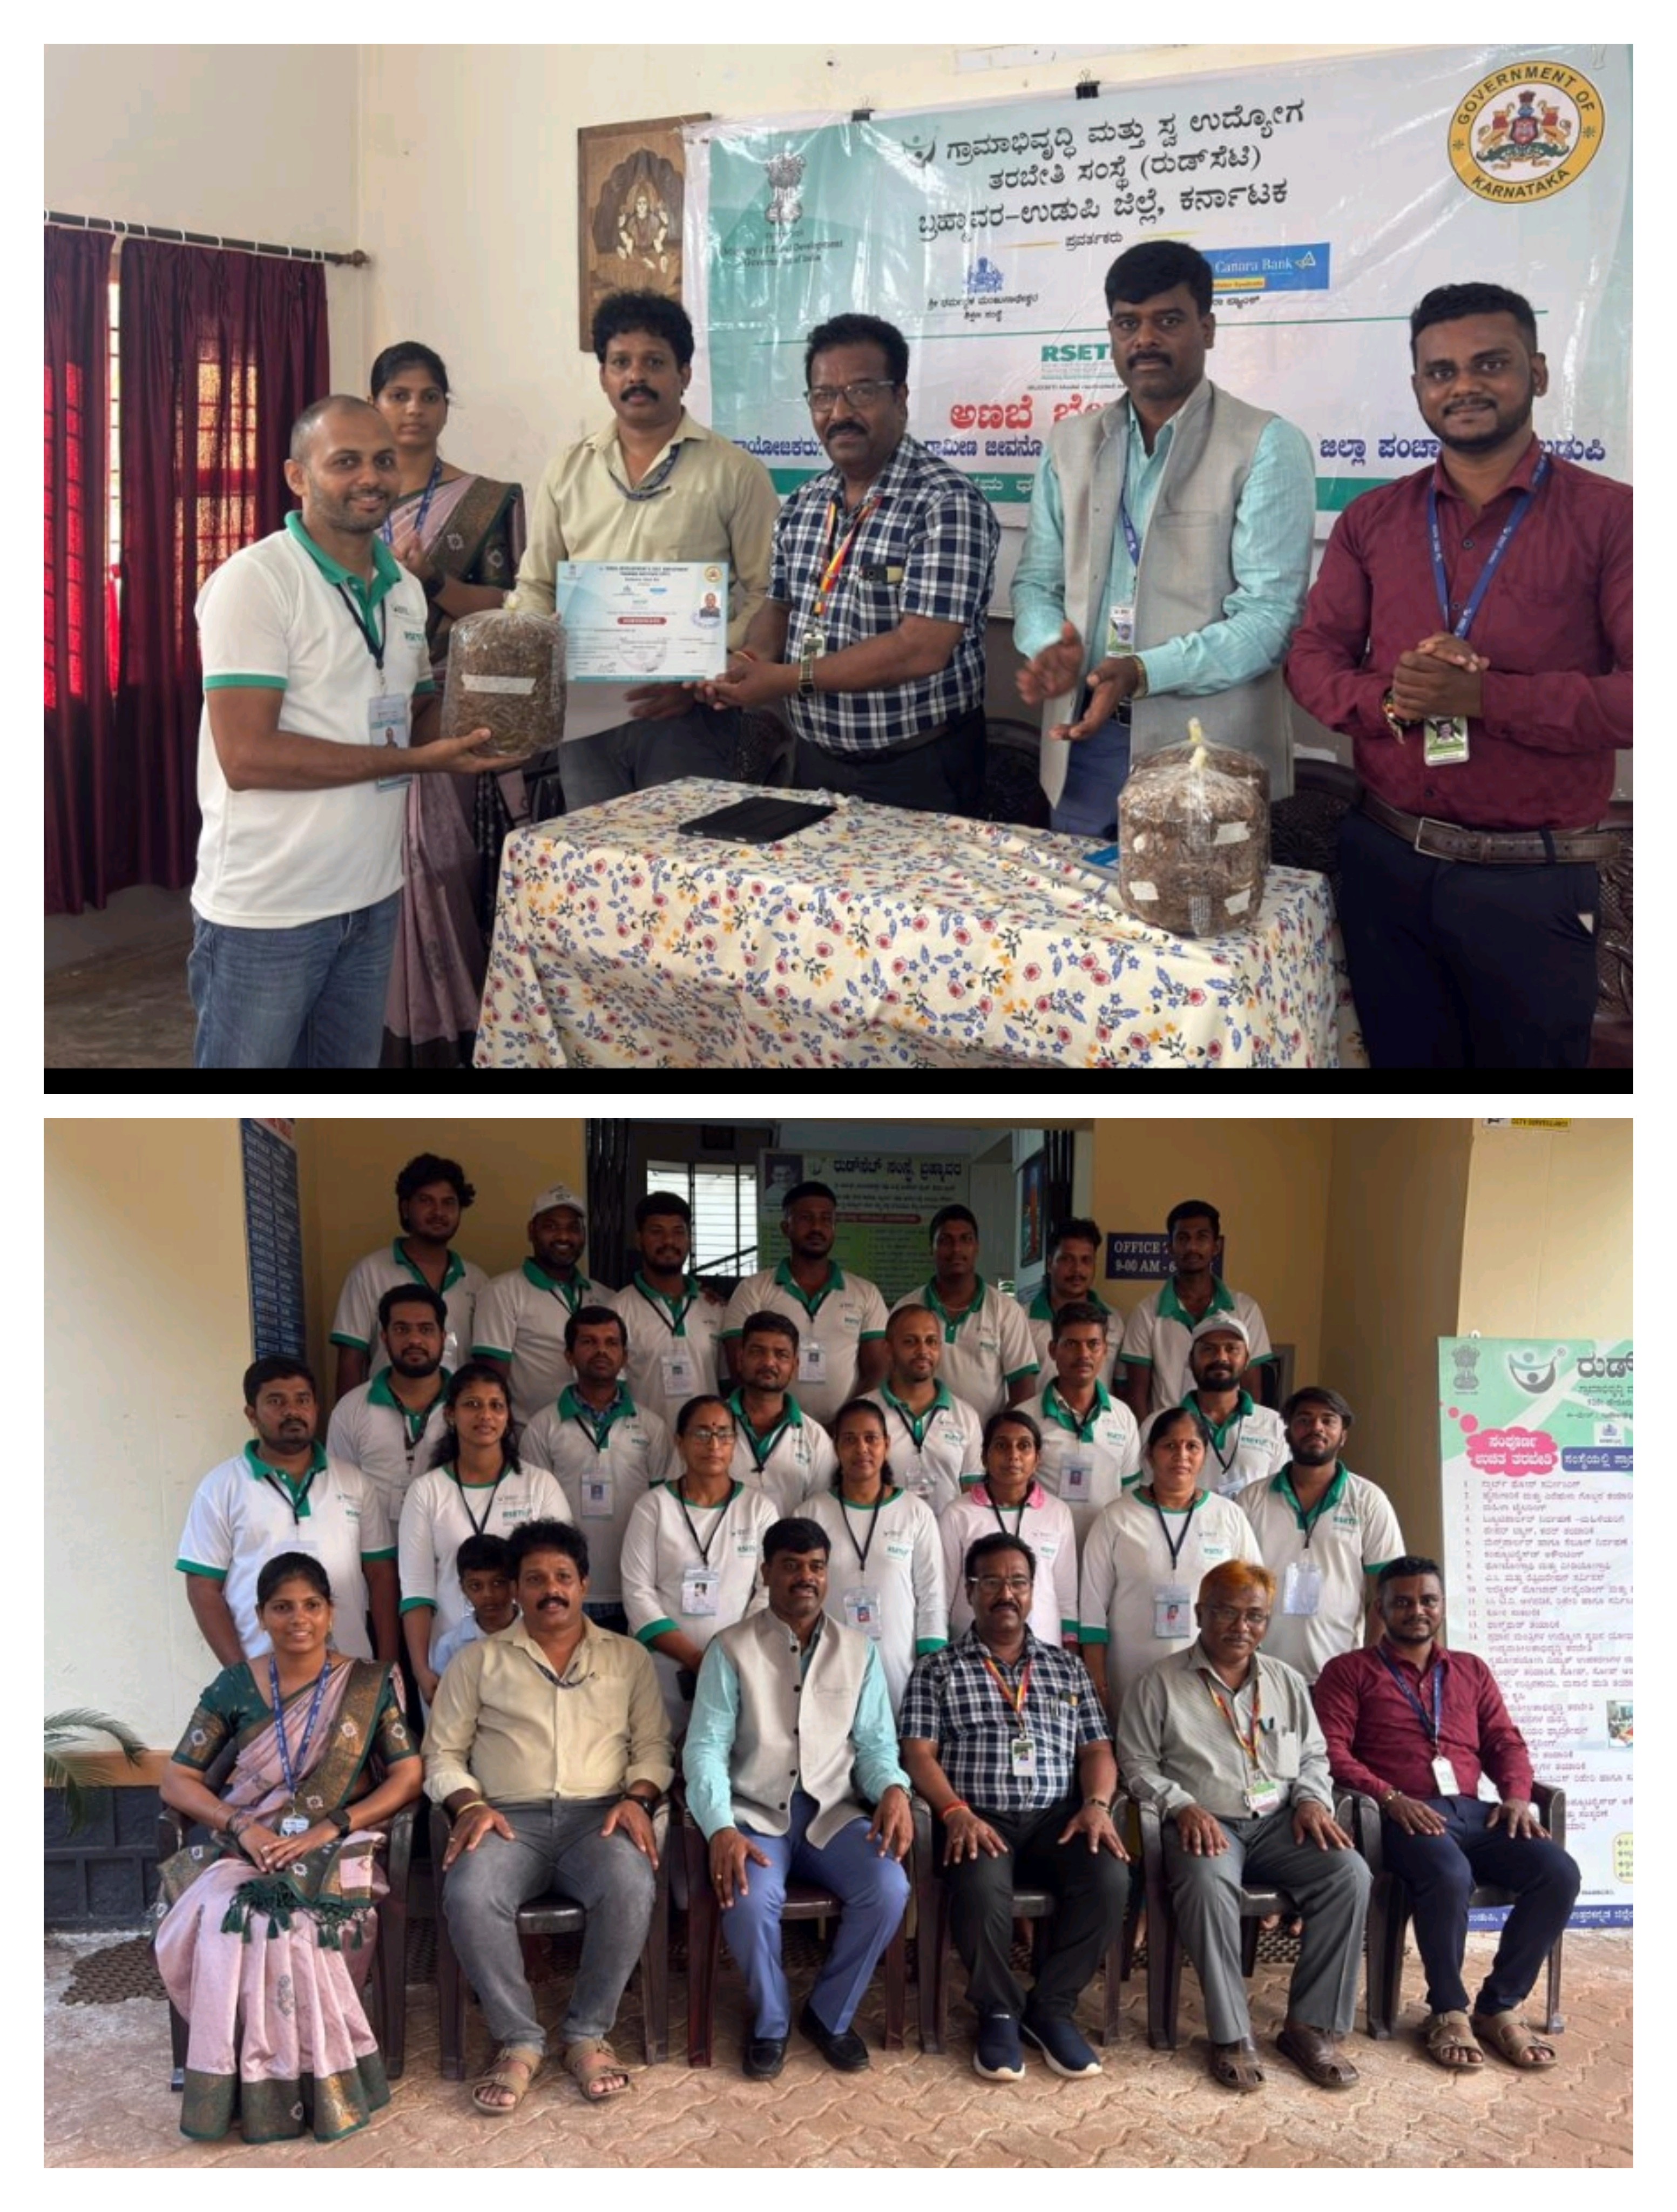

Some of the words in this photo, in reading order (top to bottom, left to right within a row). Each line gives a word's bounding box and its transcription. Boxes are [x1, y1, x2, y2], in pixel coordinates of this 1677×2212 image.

[1458, 66, 1578, 124] GOVERNMENT
[1576, 91, 1595, 112] OF
[946, 126, 1077, 165] ಗ್ರಾಮಾಭಿವೃದ್ಧಿ
[1088, 117, 1145, 149] ಮತ್ತು
[1158, 113, 1178, 146] ಸ್ವ
[1190, 99, 1304, 138] ಉದ್ಯೋಗ
[989, 163, 1065, 191] ತರಬೇತಿ
[1078, 155, 1130, 190] ಸಂಸ್ಥೆ
[1472, 168, 1570, 198] KARNATAKA
[1114, 188, 1165, 225] ಜಿಲ್ಲೆ,
[1180, 179, 1288, 211] ಕರ್ನಾಟಕ
[1215, 261, 1258, 273] Canara
[1262, 258, 1293, 270] Bank
[1041, 343, 1110, 362] RSET
[950, 395, 1033, 429] ಅಣಬೆ
[1321, 436, 1367, 467] ಜಿಲ್ಲಾ
[1378, 432, 1441, 458] ಪಂಚಾ
[1114, 1241, 1160, 1253] OFFICE
[1139, 1260, 1161, 1272] AM
